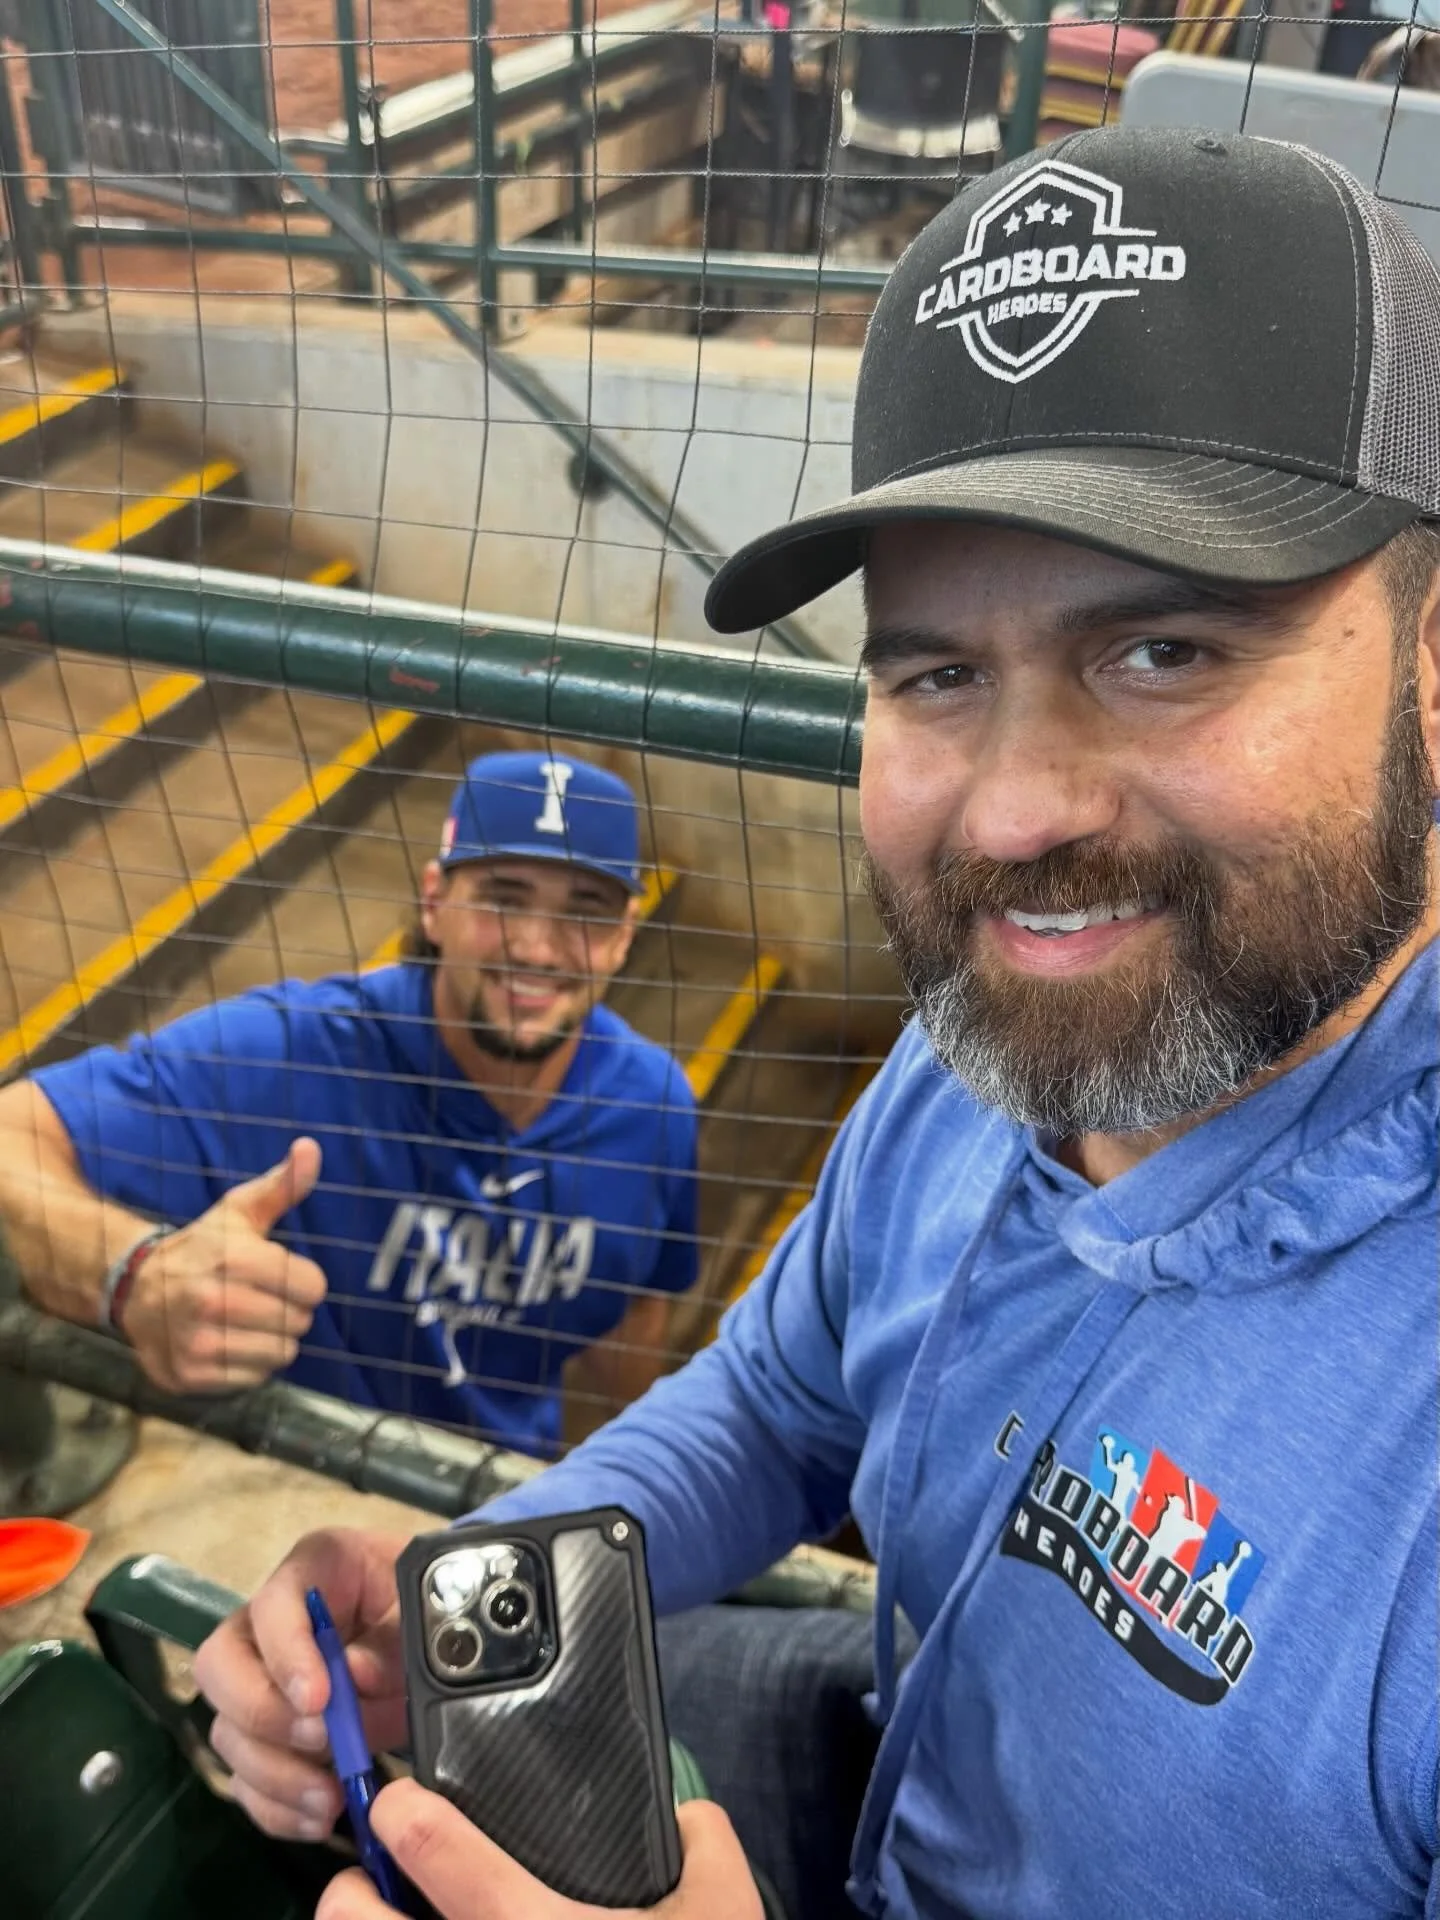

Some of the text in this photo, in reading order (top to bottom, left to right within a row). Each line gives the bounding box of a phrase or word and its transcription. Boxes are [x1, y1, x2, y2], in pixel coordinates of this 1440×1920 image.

[914, 244, 1187, 325] CARDBOARD
[986, 293, 1068, 326] HEROES
[534, 760, 575, 835] I
[367, 1202, 596, 1307] ITALIA
[1013, 1507, 1136, 1643] HEROES
